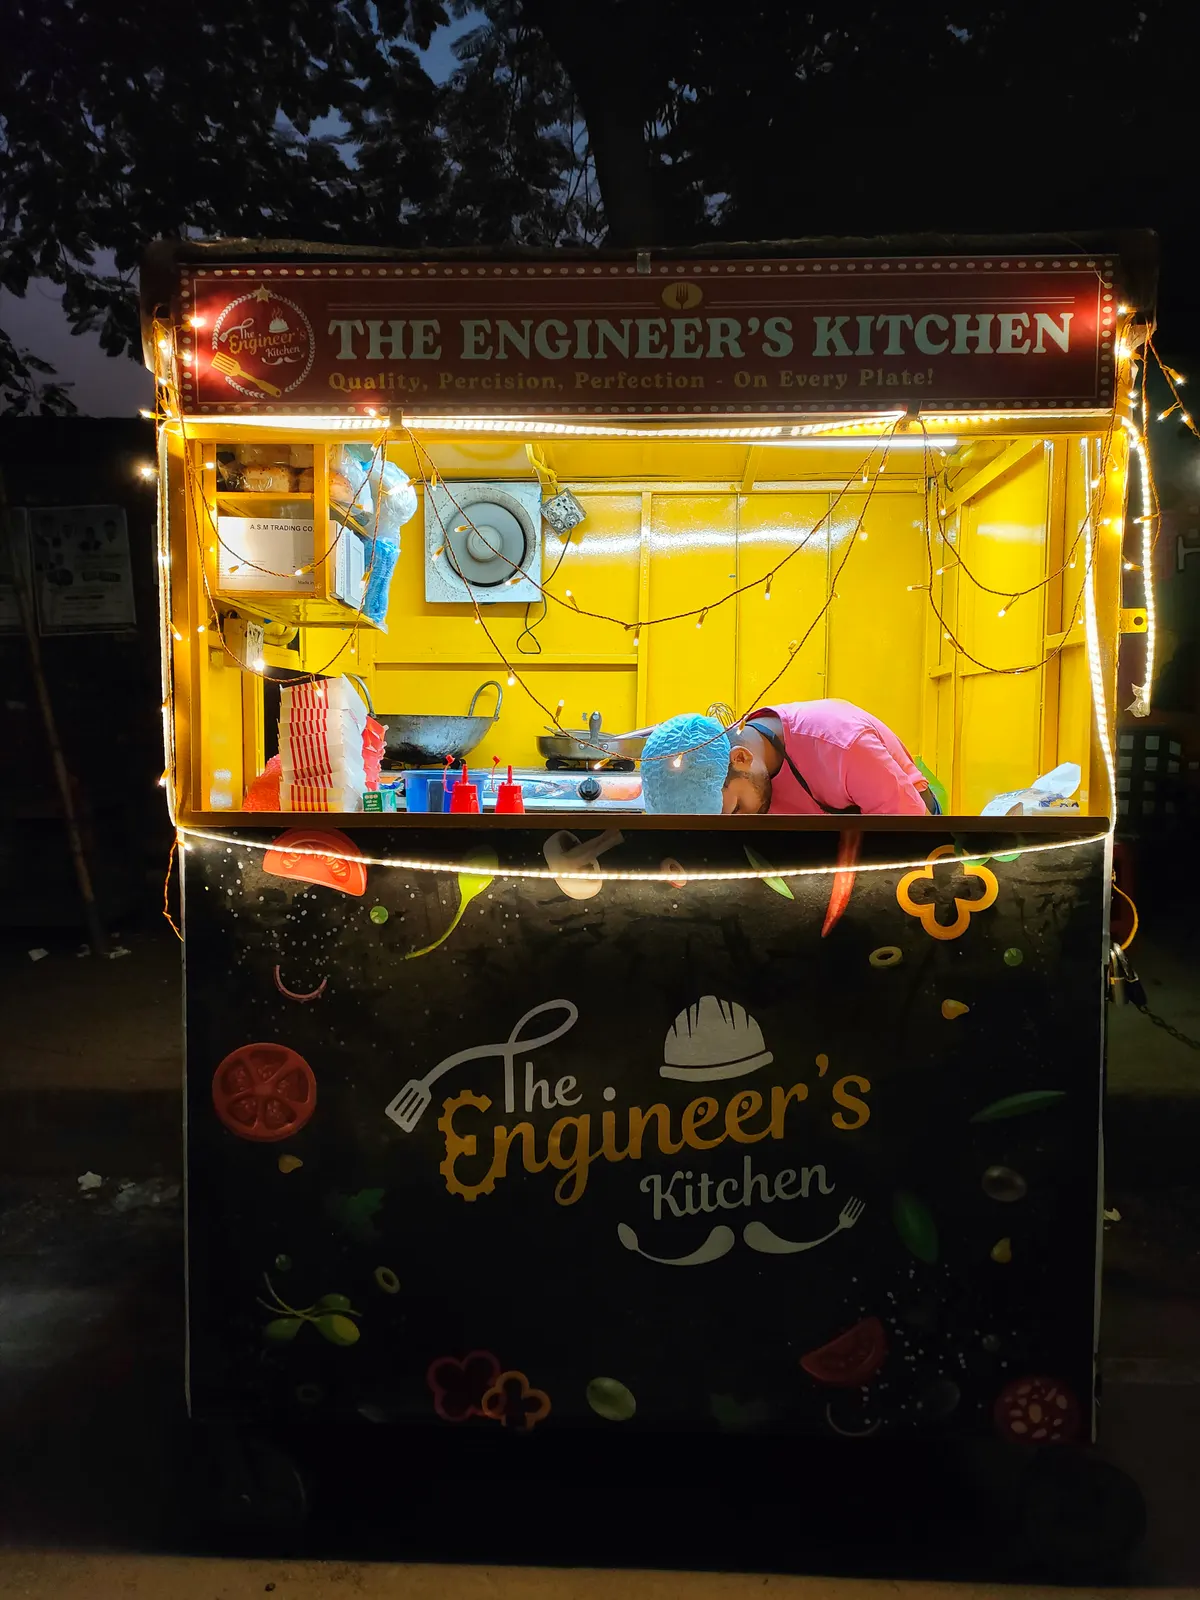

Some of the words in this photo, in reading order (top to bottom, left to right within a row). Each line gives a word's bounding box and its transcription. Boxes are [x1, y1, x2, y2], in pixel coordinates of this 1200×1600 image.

[229, 328, 307, 355] Engineer's
[328, 319, 442, 360] THE
[459, 316, 794, 360] ENGINEER'S
[811, 312, 1075, 358] KITCHEN
[265, 345, 300, 358] Kitchen
[328, 372, 429, 393] Quality,
[438, 371, 564, 392] Percision,
[574, 371, 704, 389] Perfection
[733, 370, 768, 388] On
[779, 369, 848, 390] Every
[859, 368, 934, 387] Plate!
[271, 524, 301, 532] TRADING
[437, 1053, 871, 1206] Engineer's
[639, 1155, 836, 1221] Kitchen
